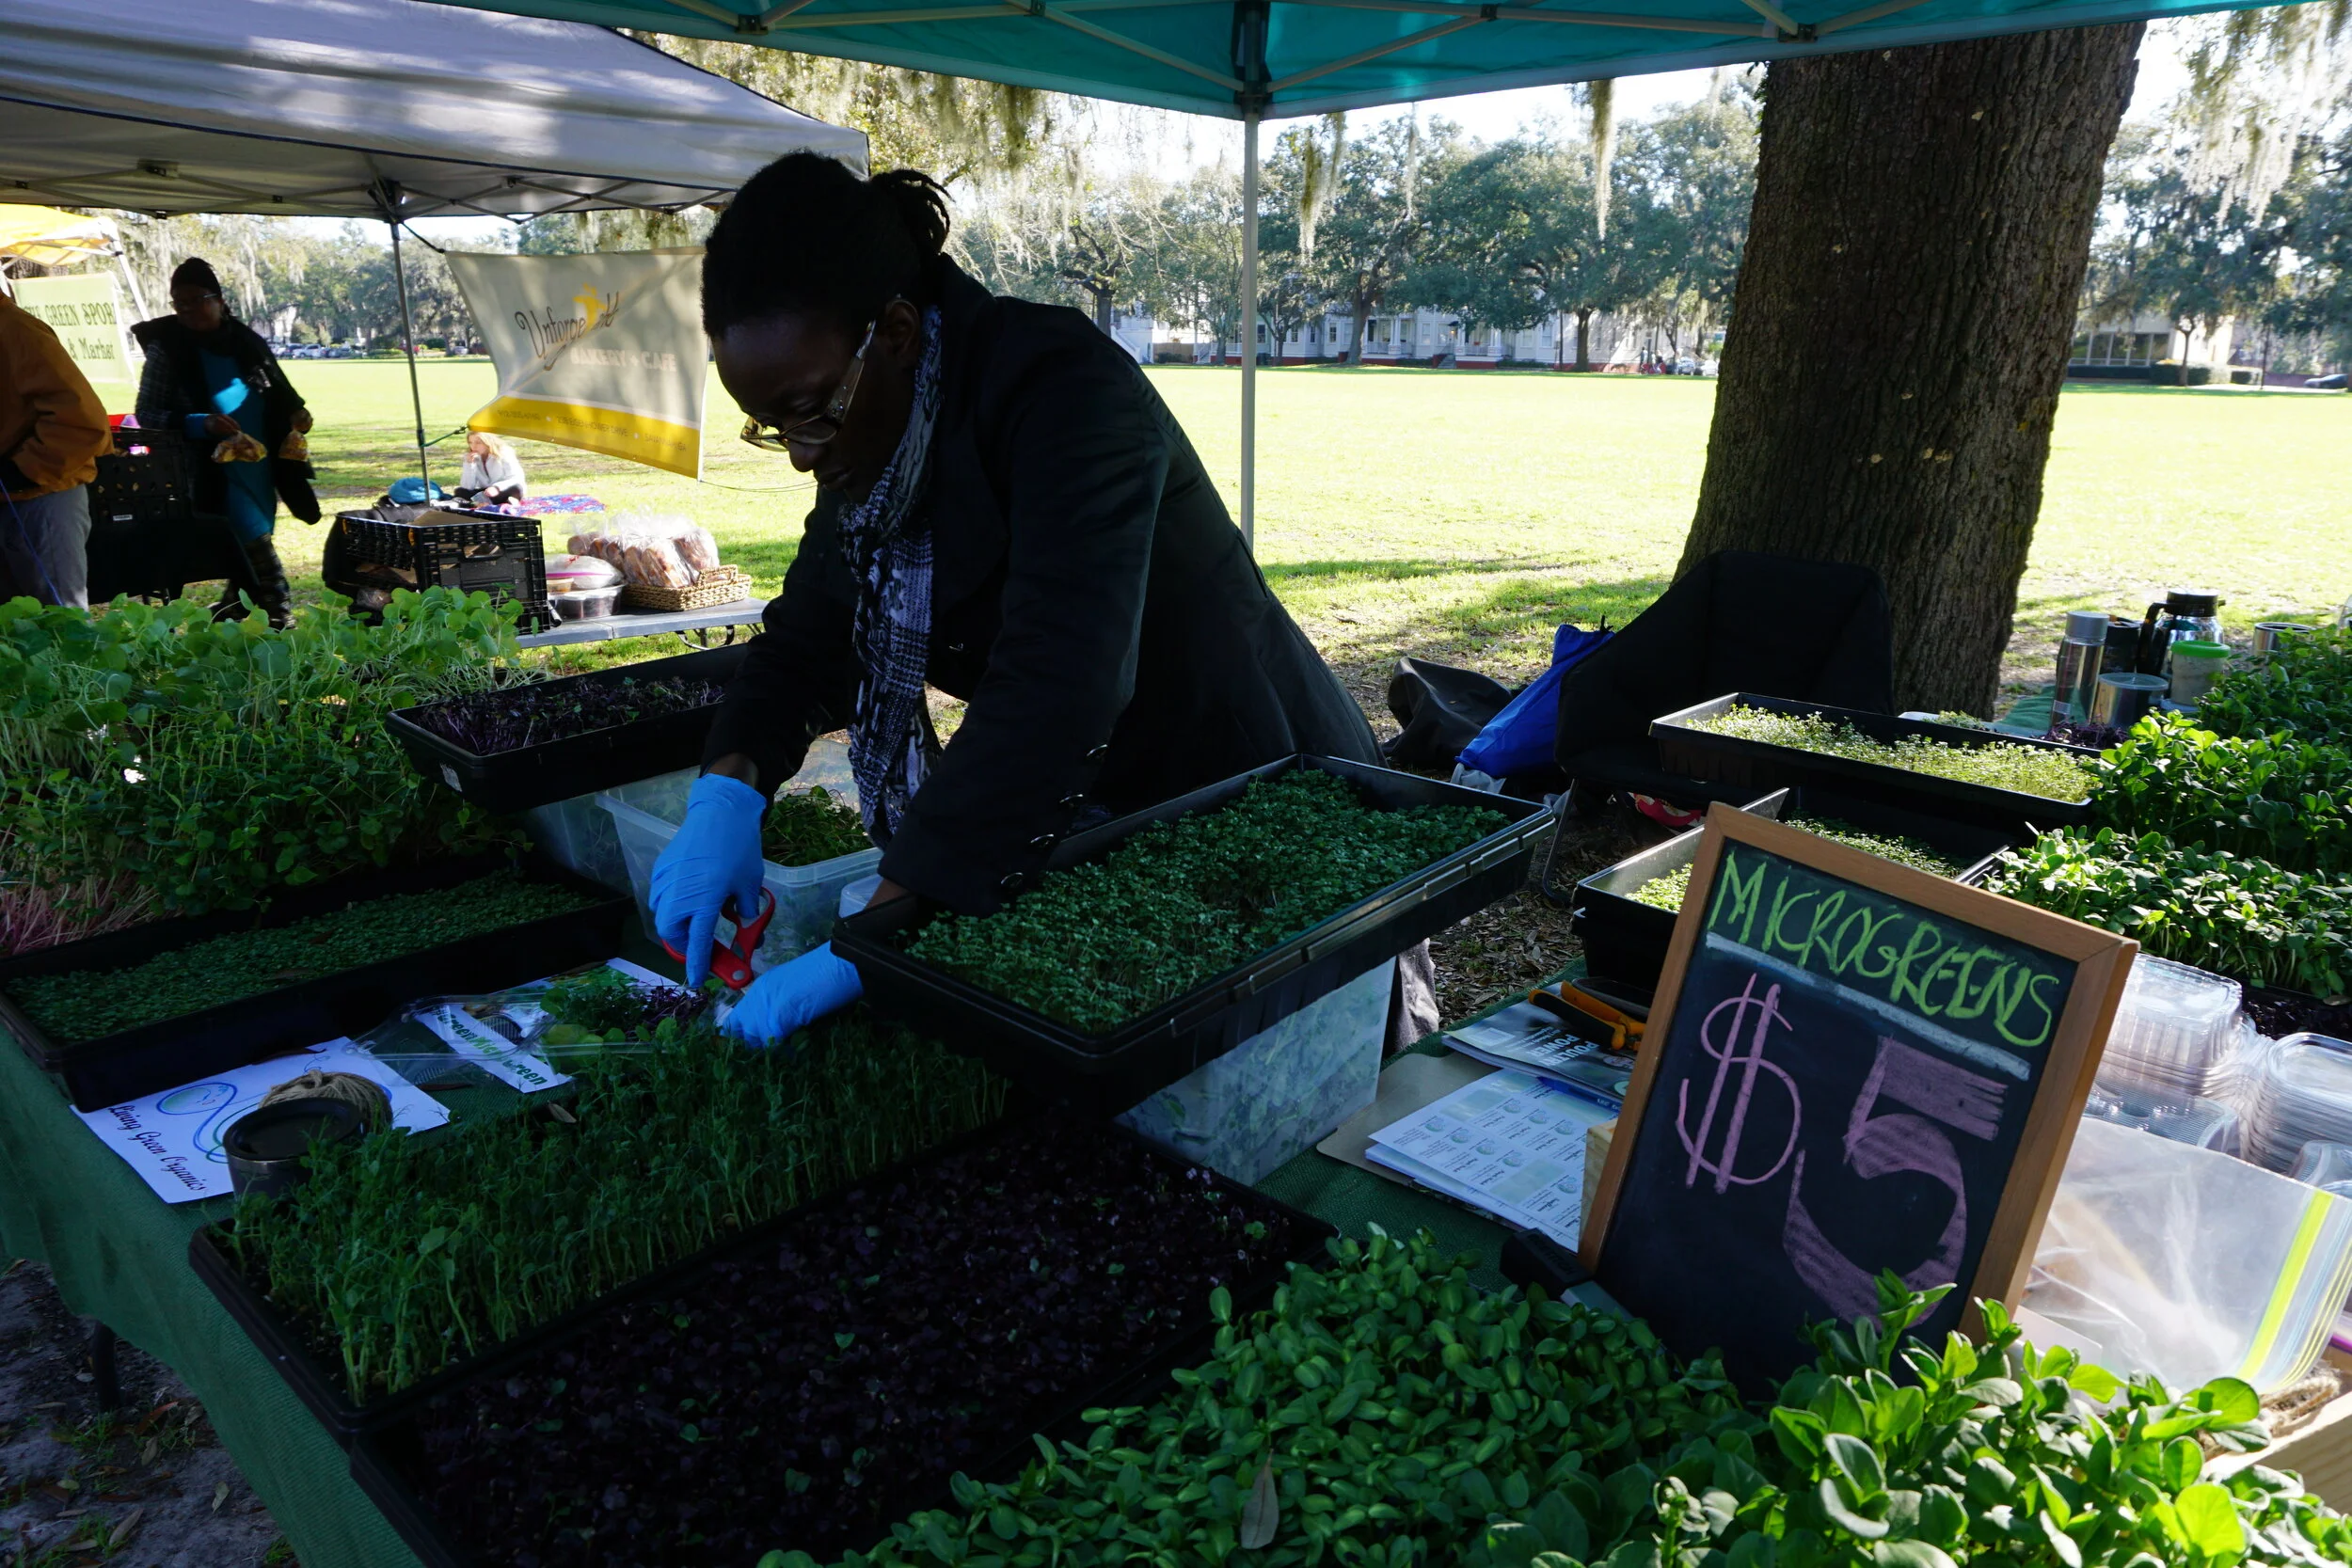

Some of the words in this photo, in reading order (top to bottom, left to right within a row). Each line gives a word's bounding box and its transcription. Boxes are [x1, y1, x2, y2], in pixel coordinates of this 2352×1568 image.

[45, 304, 80, 326] GREEN
[68, 338, 78, 359] &
[78, 337, 115, 360] Market
[641, 350, 678, 373] CAFE
[1707, 851, 2060, 1047] MICROGREENS
[1526, 1034, 1581, 1056] POWER
[1539, 1040, 1600, 1067] POULTRY
[107, 1104, 142, 1131] Living
[127, 1131, 167, 1155] Green
[160, 1156, 207, 1191] Organics
[1675, 973, 2009, 1329] $5
